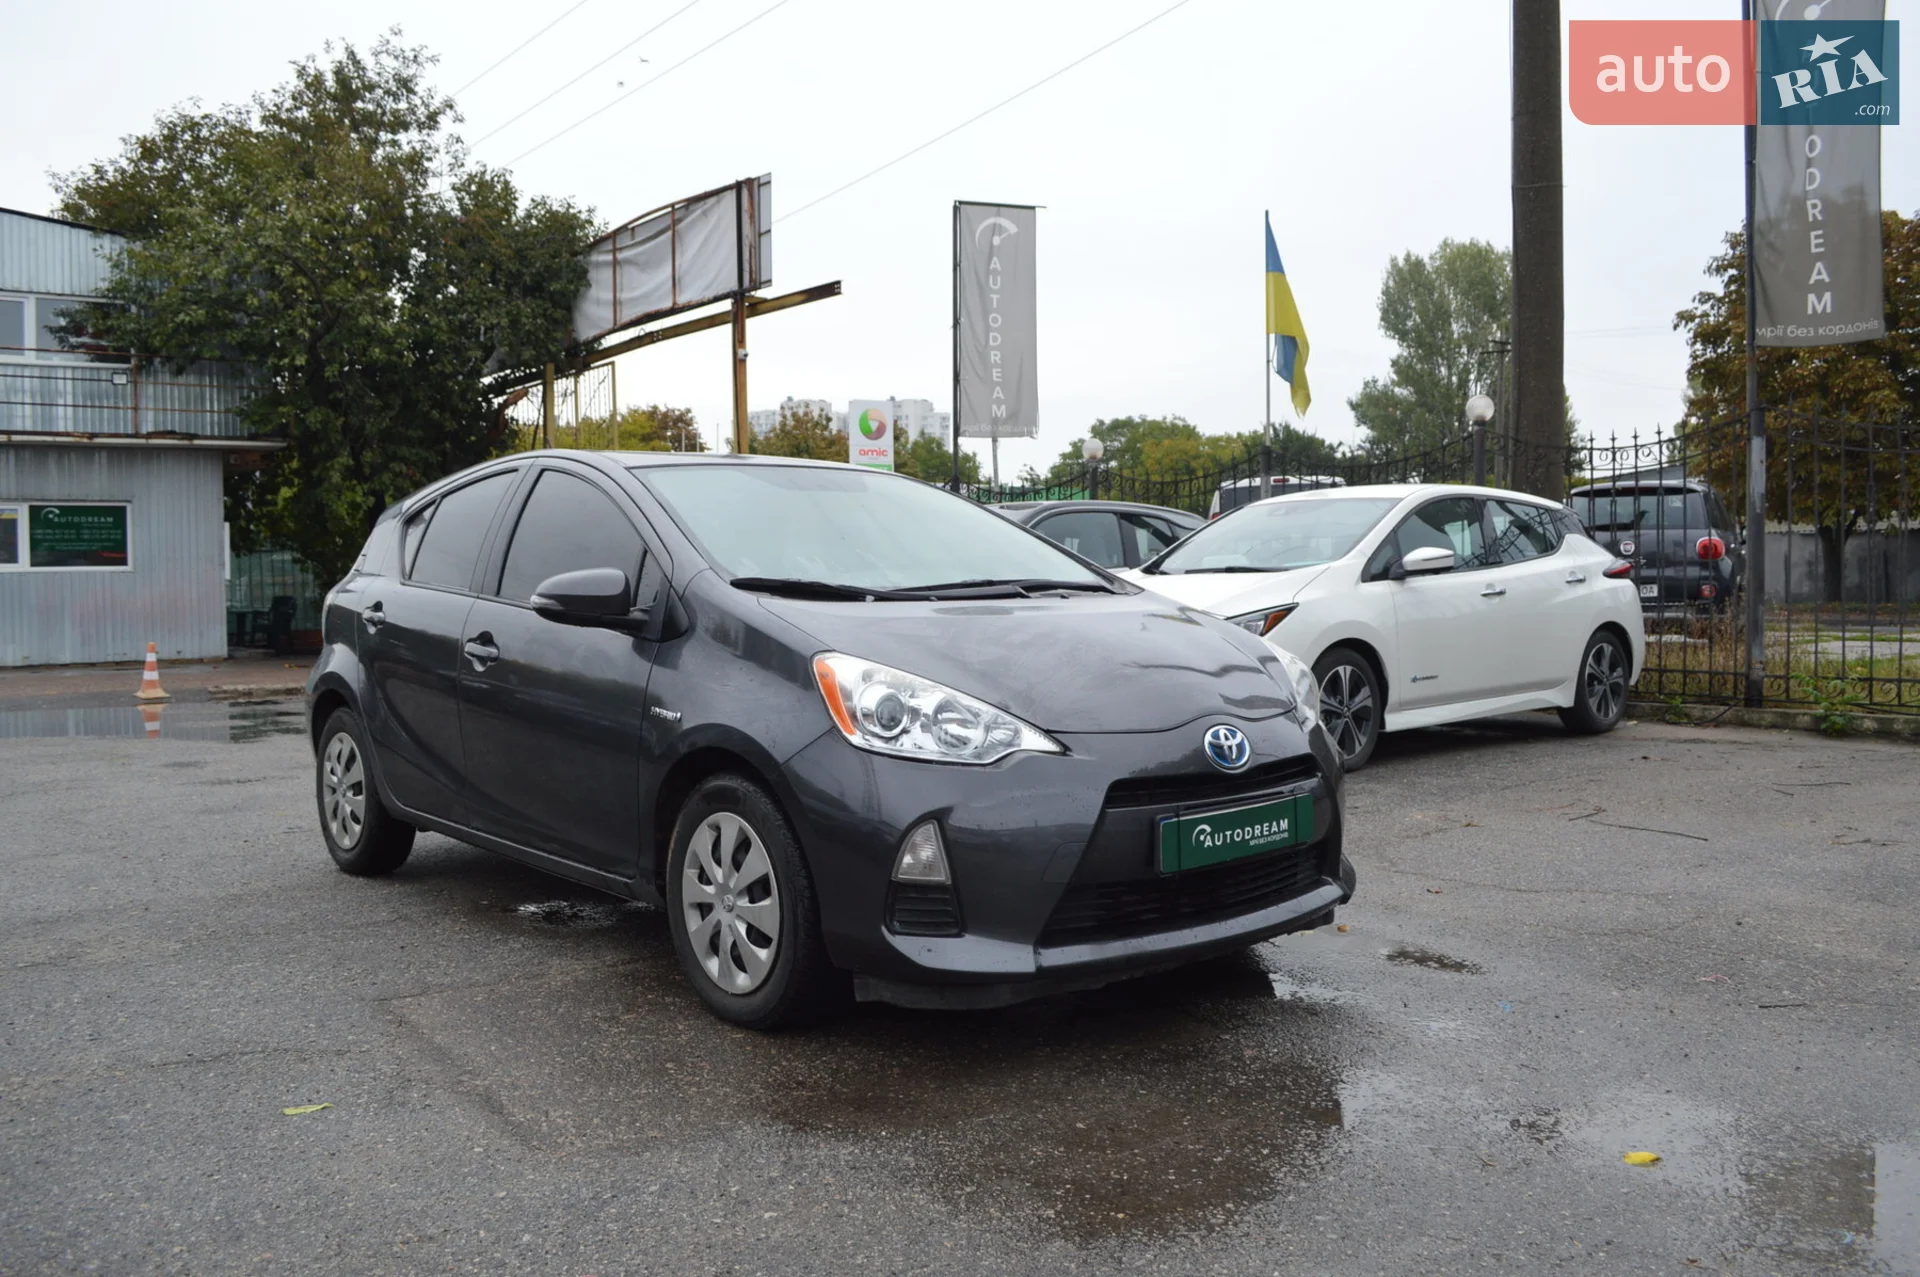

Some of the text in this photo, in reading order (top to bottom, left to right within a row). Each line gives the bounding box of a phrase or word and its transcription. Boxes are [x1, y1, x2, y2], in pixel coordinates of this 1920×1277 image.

[988, 256, 1007, 419] AUTODREAM
[1787, 324, 1815, 338] без
[858, 447, 889, 457] amic
[1203, 817, 1289, 848] AUTODREAM
